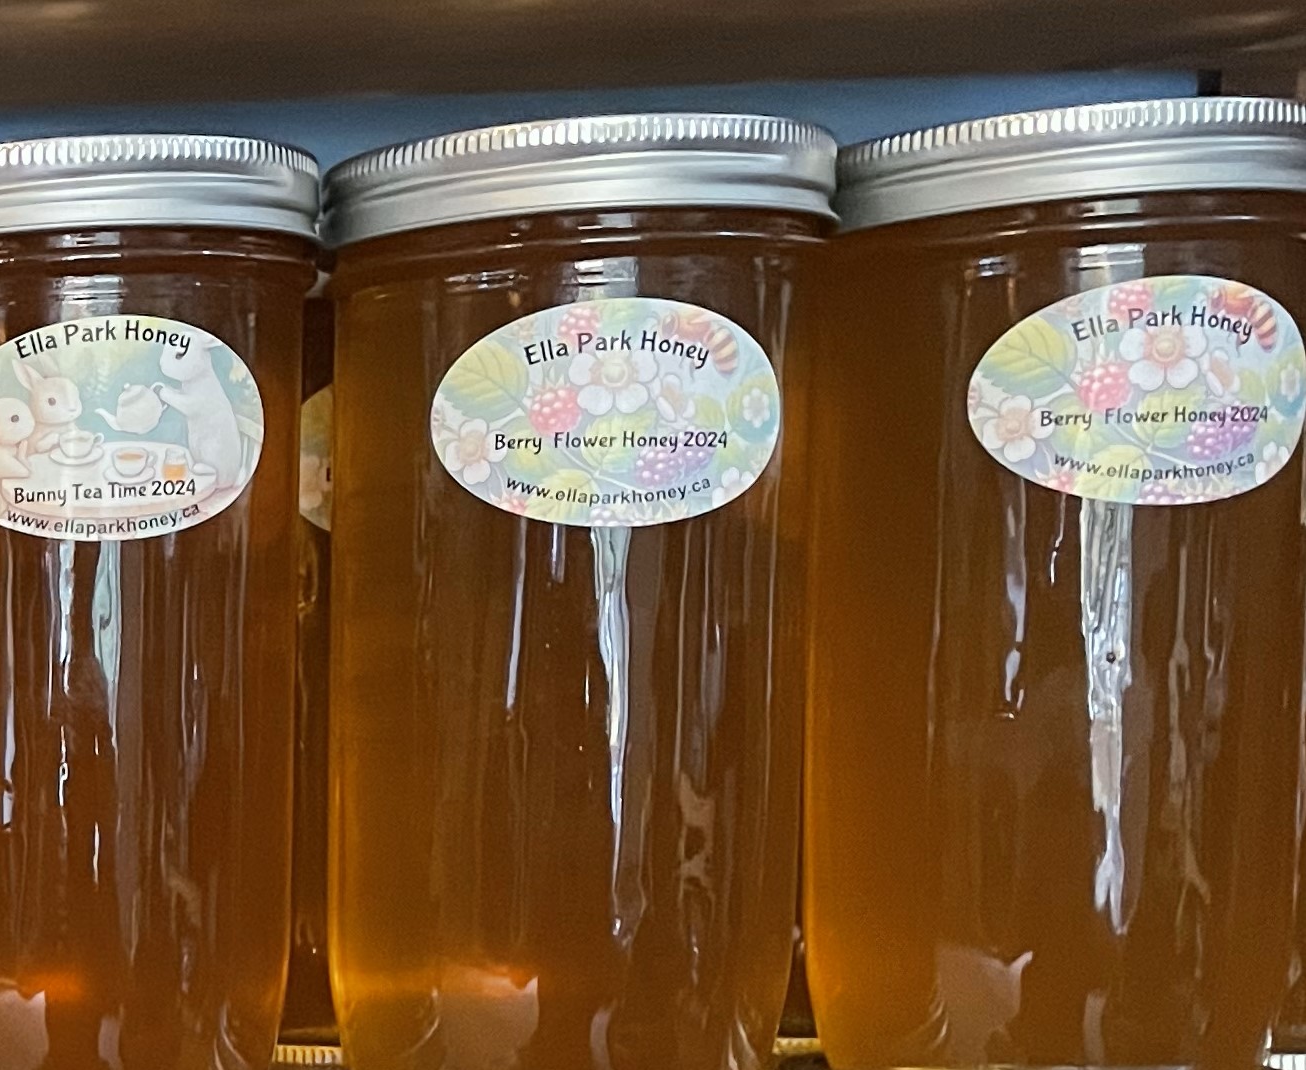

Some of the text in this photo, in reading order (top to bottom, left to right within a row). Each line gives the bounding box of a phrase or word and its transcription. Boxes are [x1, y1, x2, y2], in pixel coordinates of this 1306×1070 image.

[14, 320, 190, 359] Ella Park Honey
[1071, 305, 1252, 344] Ella Park Honey
[524, 330, 709, 369] Ella Park Honey
[1040, 406, 1267, 430] Berry Flower Honey 2024
[494, 431, 727, 454] Berry Flower Honey 2024
[1054, 452, 1255, 482] www.ellaparkhoney.ca
[14, 479, 196, 506] Bunny Tea Time 2024
[507, 477, 711, 506] www.ellaparkhoney.ca
[7, 503, 200, 538] www.ellaparkhoney.ca
